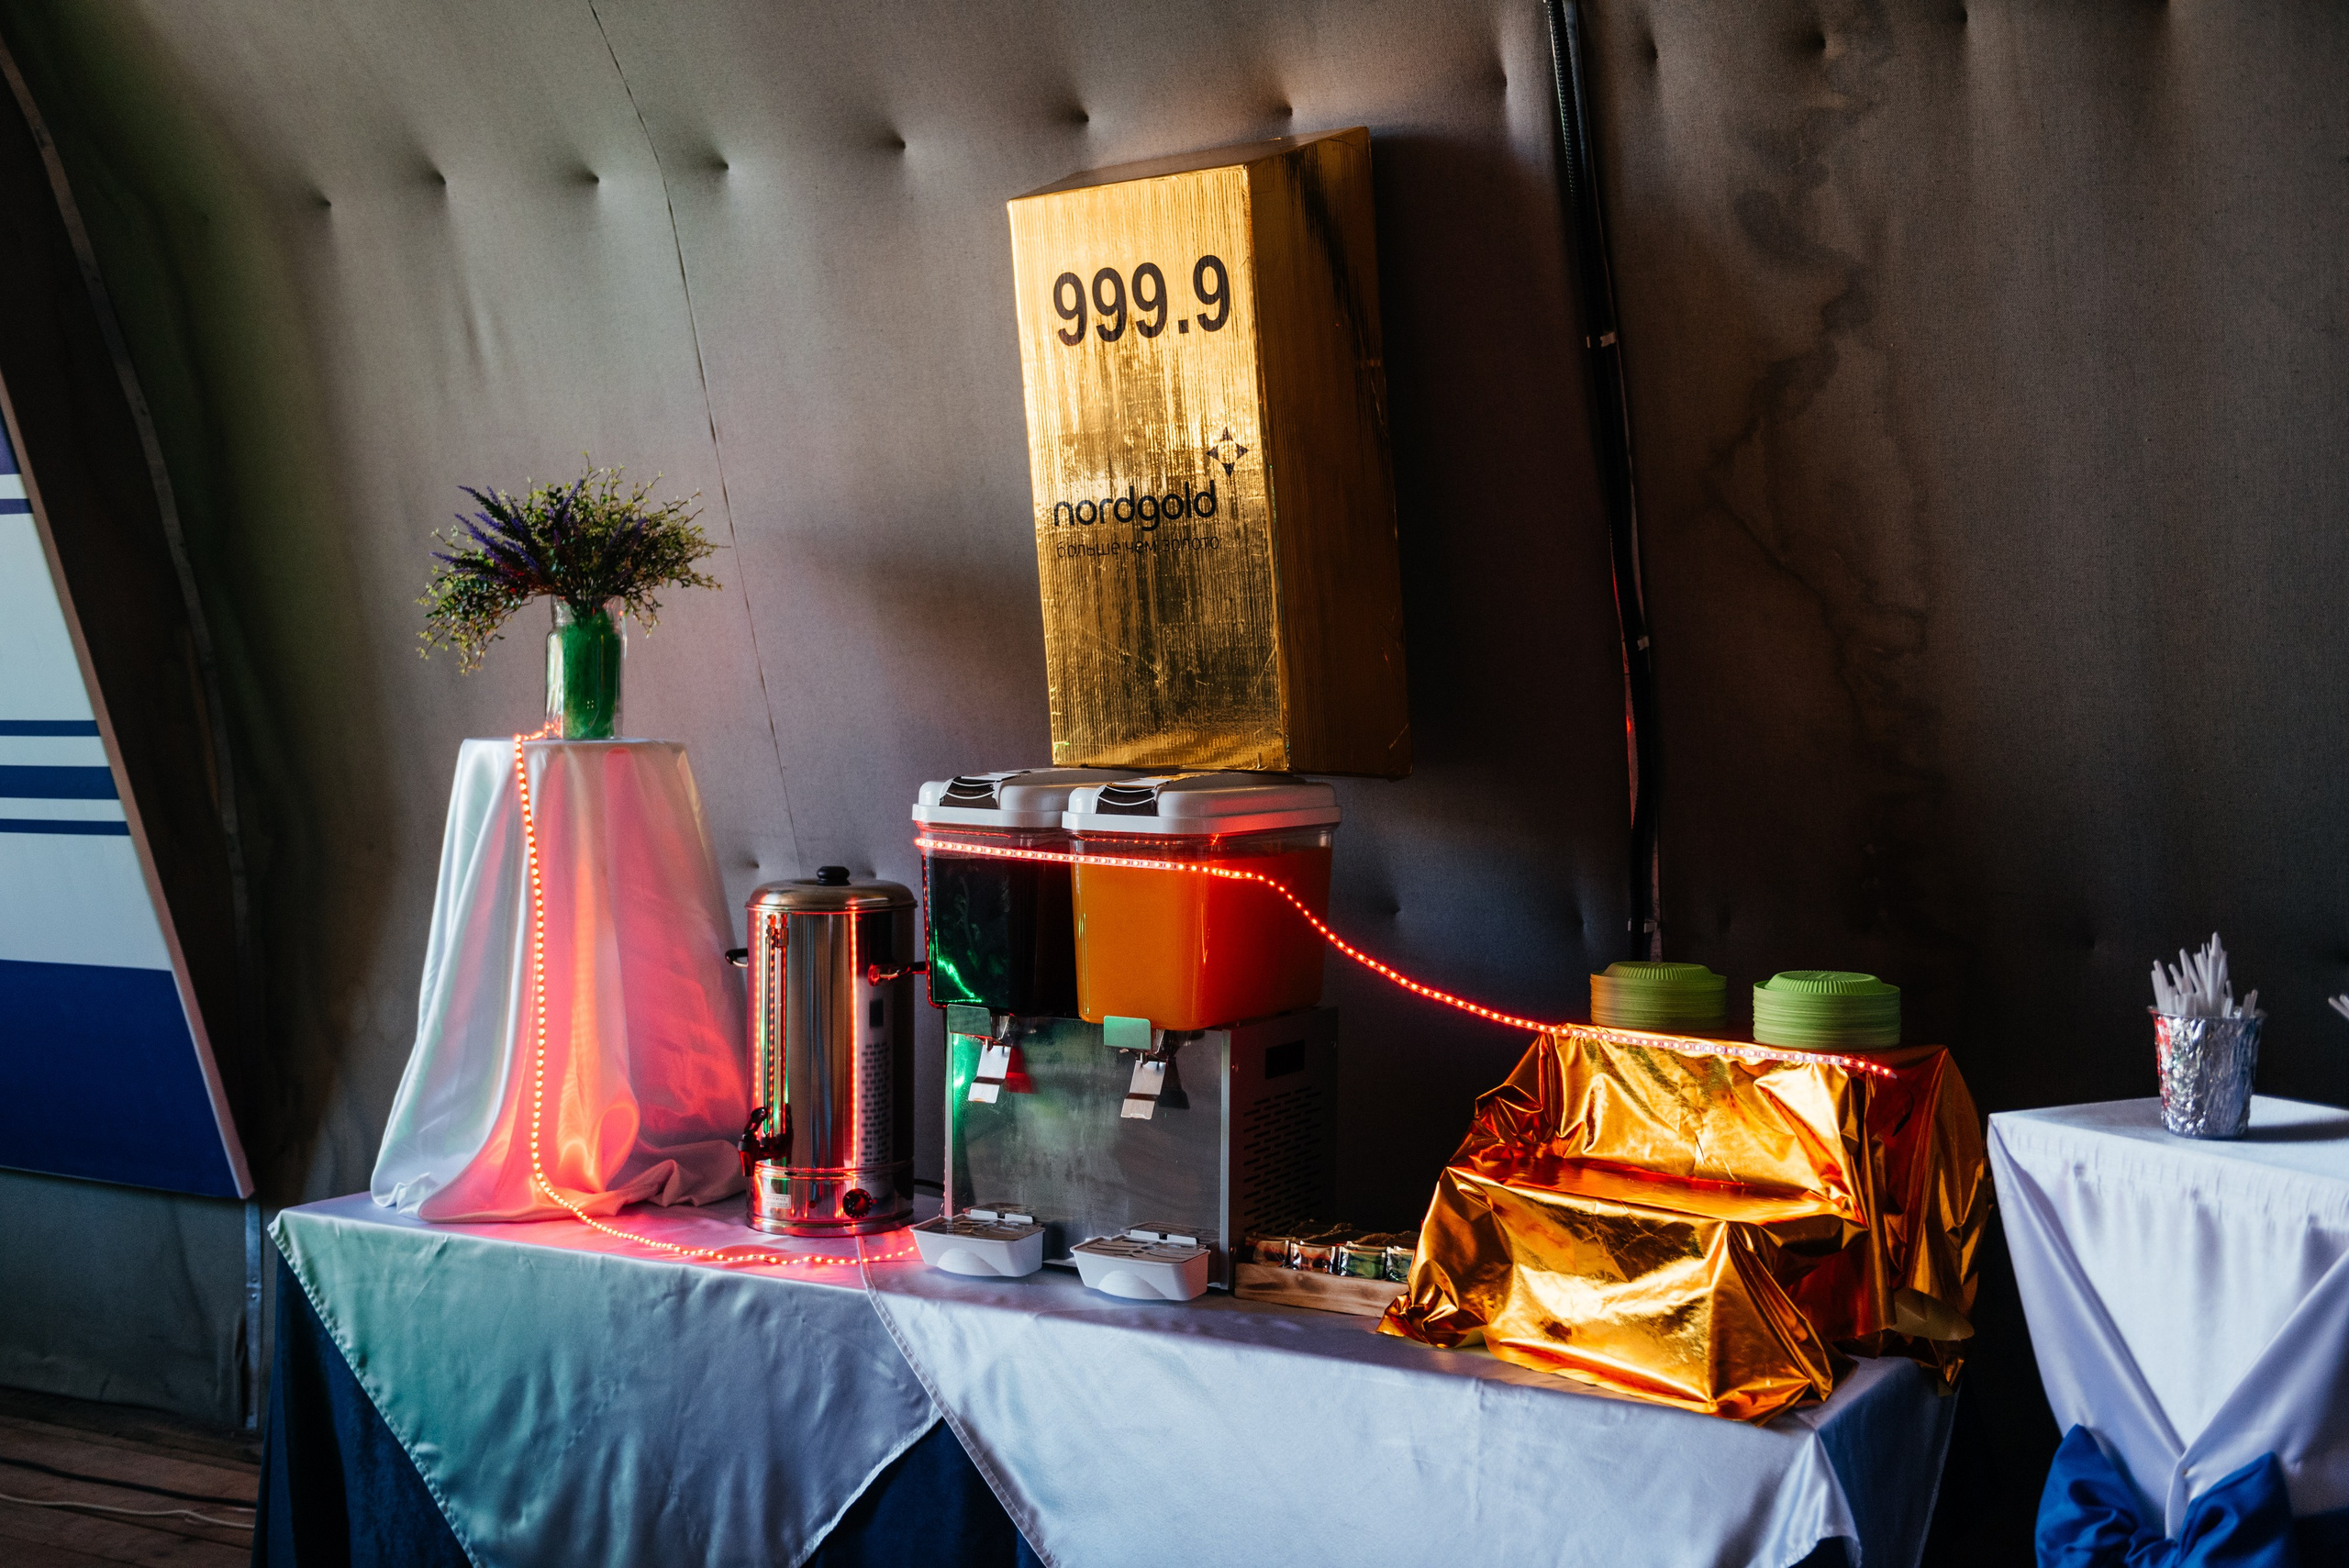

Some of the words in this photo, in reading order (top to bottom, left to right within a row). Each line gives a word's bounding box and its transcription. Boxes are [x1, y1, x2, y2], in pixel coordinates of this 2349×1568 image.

[1053, 254, 1230, 347] 999.9
[1053, 480, 1218, 532] nordgold
[1056, 540, 1120, 559] больше
[1125, 539, 1157, 553] чем
[1162, 536, 1220, 552] золото
